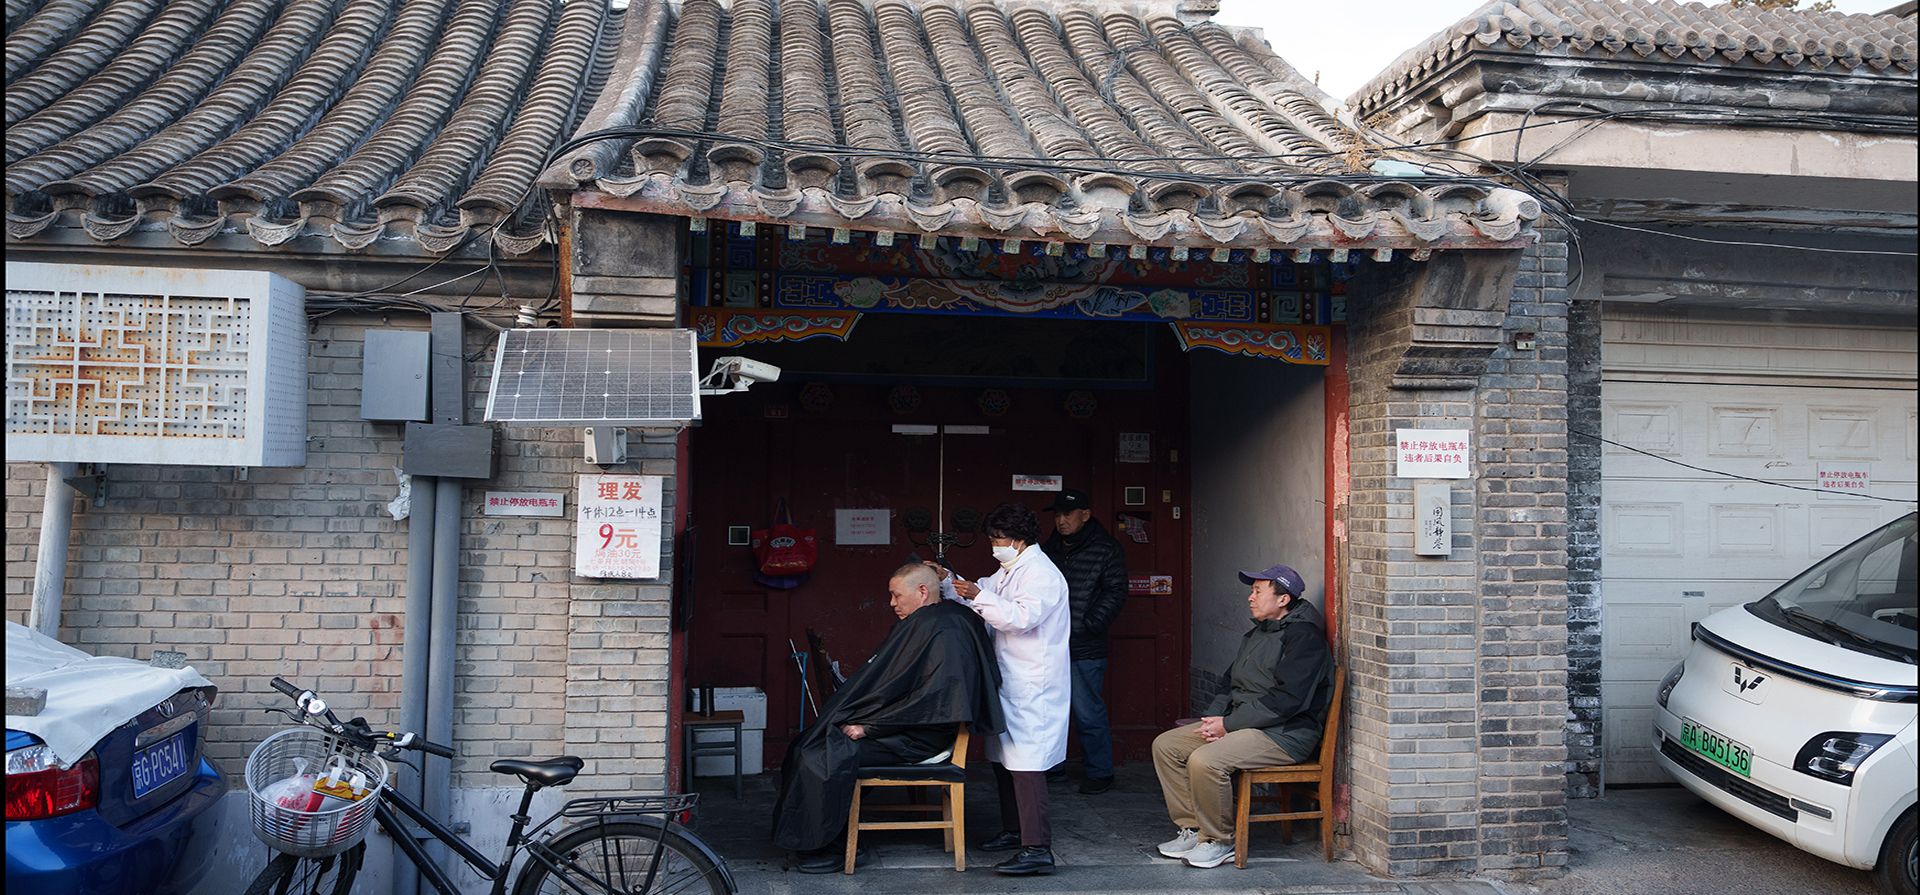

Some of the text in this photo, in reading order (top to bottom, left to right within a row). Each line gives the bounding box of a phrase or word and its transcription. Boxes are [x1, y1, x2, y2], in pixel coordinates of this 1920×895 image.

[1400, 441, 1467, 450] 禁止停放电瓶车
[1404, 453, 1462, 463] 违者后果自负
[1820, 471, 1868, 479] 禁止停放电瓶车
[1823, 480, 1865, 488] 违者后果自负
[598, 482, 642, 500] 理发
[489, 497, 558, 507] 禁止停放电瓶车
[599, 523, 638, 549] 9元
